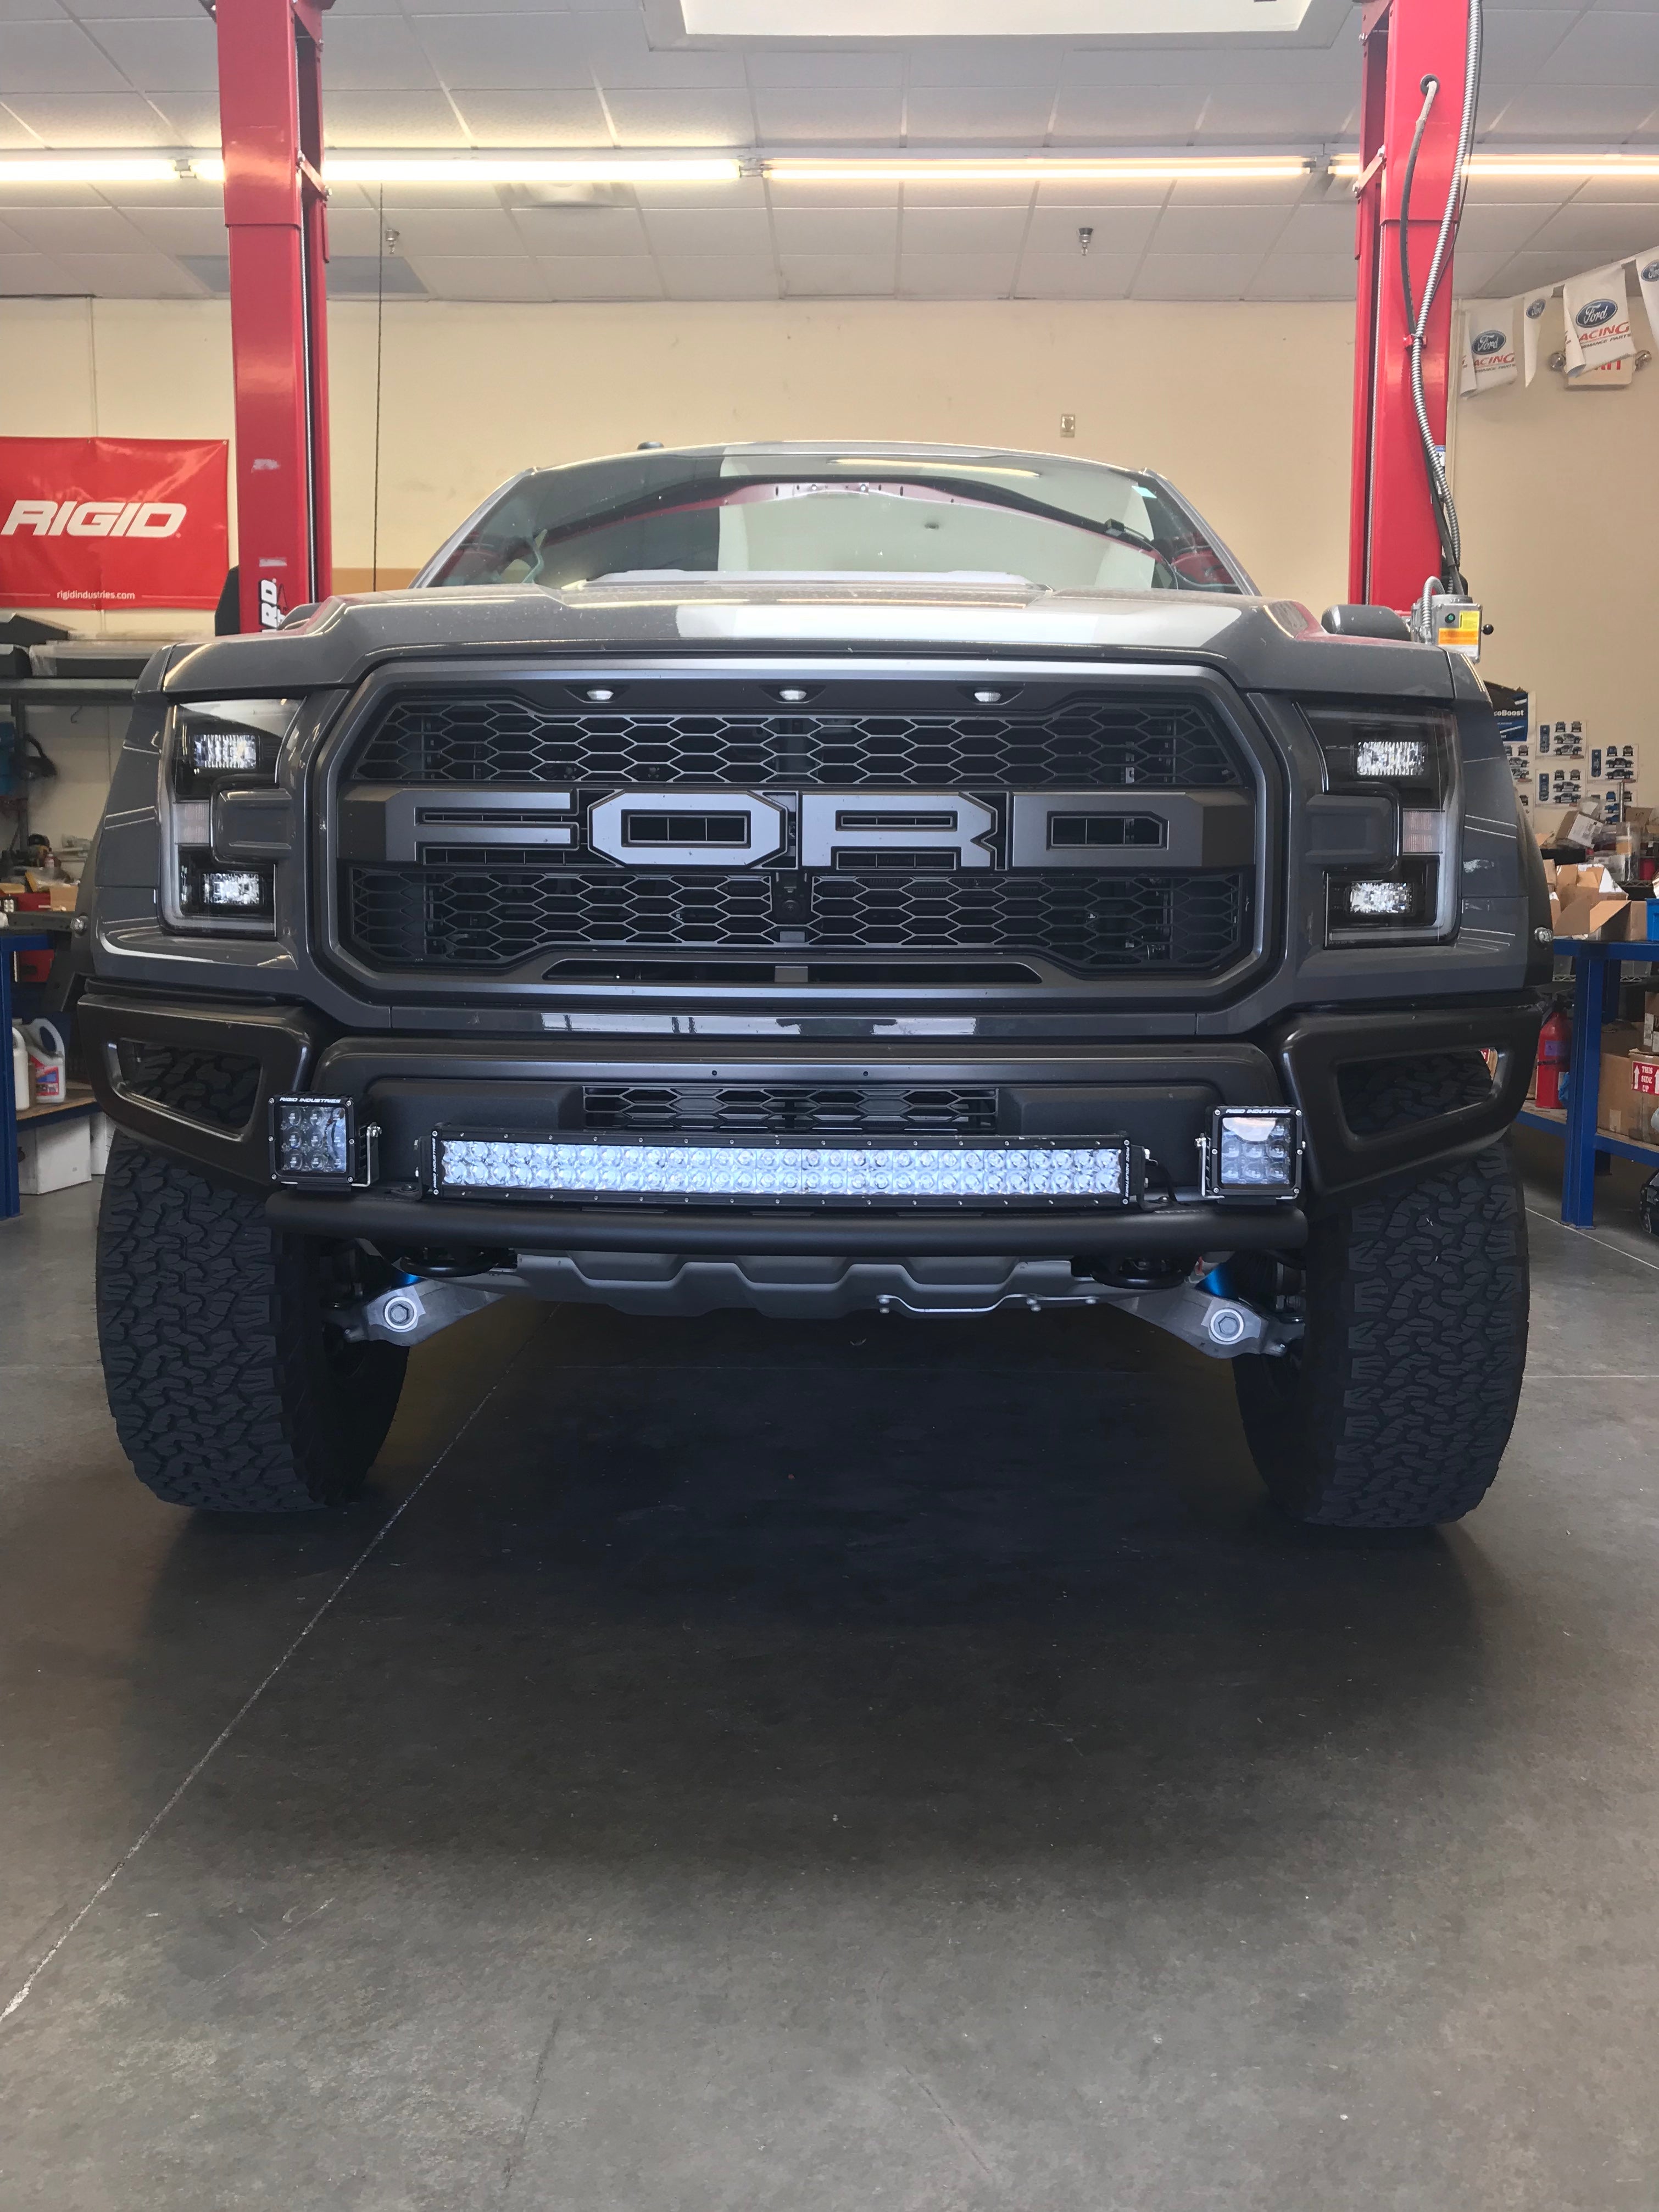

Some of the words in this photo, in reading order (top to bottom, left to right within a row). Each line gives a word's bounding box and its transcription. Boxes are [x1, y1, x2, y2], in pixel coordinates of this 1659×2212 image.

[1583, 303, 1608, 324] Ford
[1578, 321, 1630, 343] ACING
[1477, 334, 1499, 352] Ford
[1473, 352, 1516, 367] ACING
[1, 500, 187, 538] RIGID
[57, 590, 135, 600] rigidindustries.com
[385, 791, 1203, 867] FORD
[1641, 1076, 1652, 1084] SIDE
